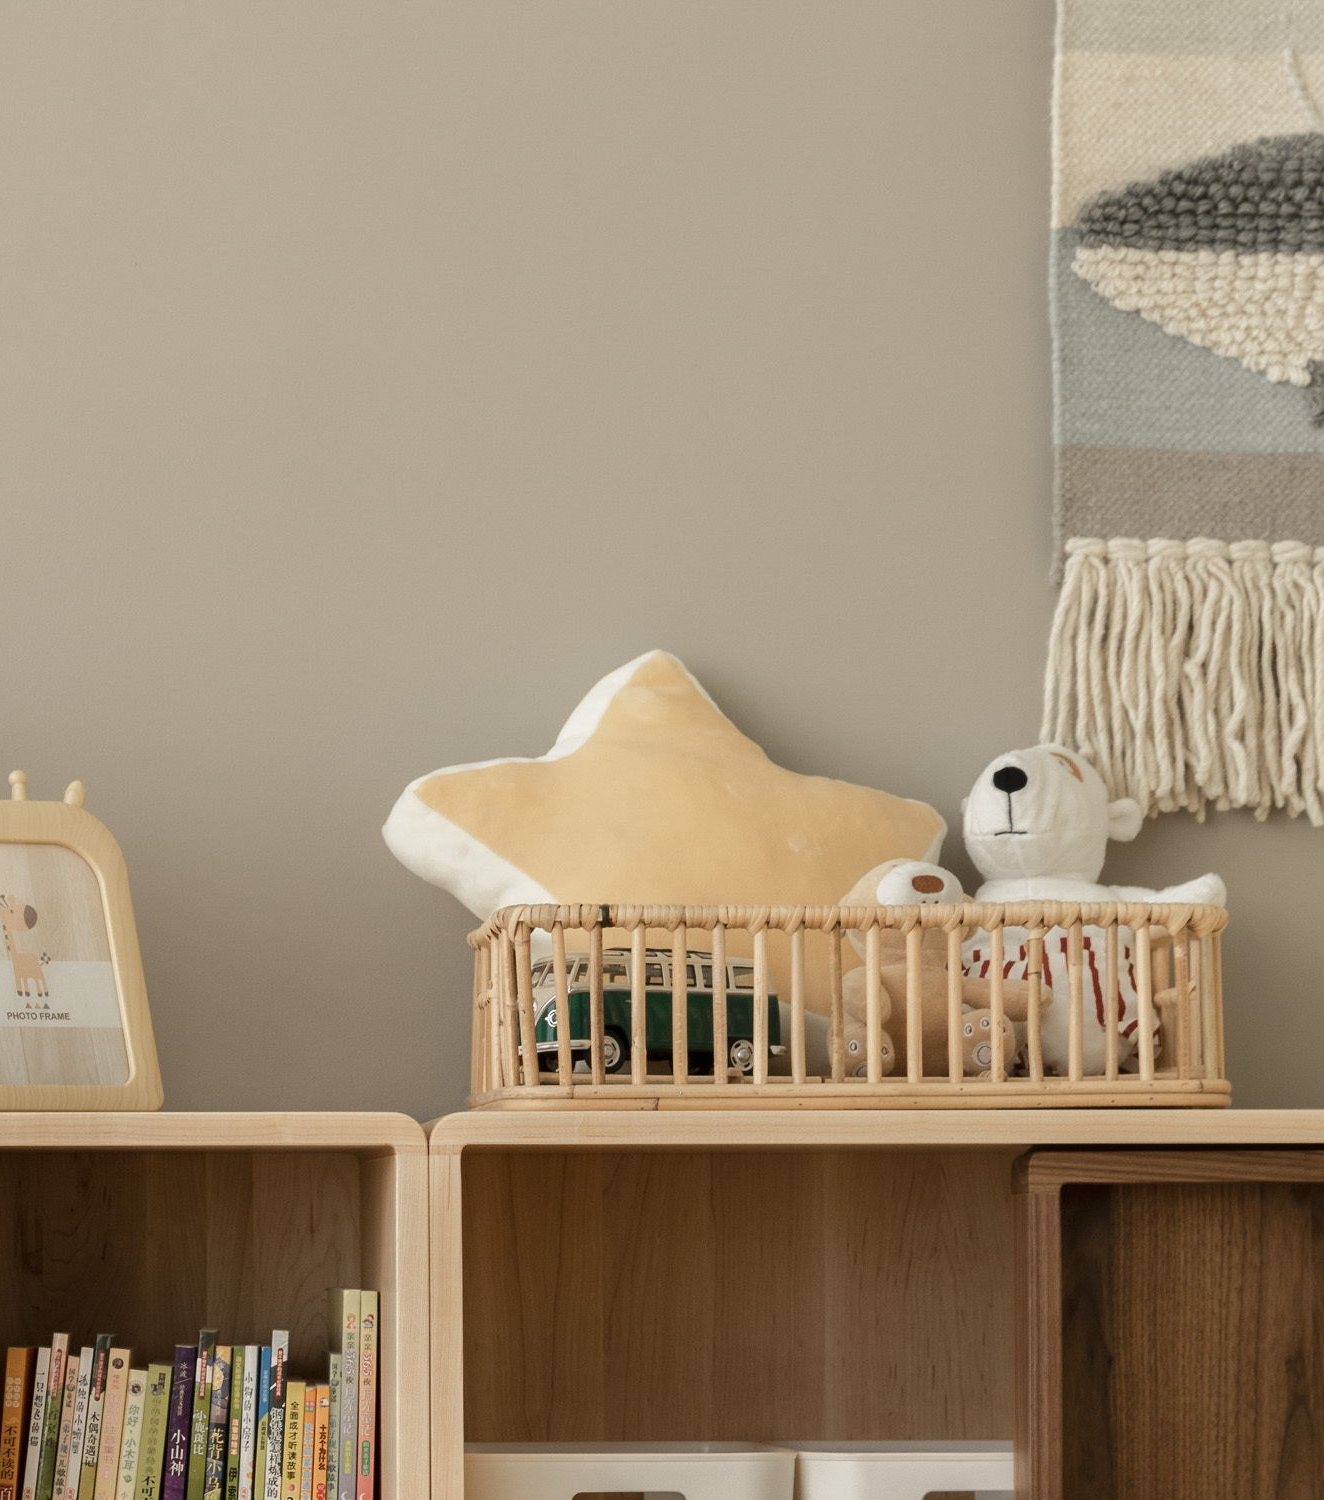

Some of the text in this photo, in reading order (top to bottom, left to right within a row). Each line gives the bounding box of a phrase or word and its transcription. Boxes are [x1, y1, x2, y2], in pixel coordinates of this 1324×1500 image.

[6, 1011, 71, 1021] PHOTO FRAME
[30, 1371, 46, 1447] 一只想飞的猫
[71, 1373, 89, 1454] 孤独的小螃蟹
[83, 1412, 100, 1468] 木偶奇遇记
[192, 1409, 207, 1456] 小鹿斑比
[242, 1371, 254, 1453] 小狗的小房子
[286, 1401, 300, 1481] 全面成才听读故事
[167, 1429, 186, 1477] 小山神
[266, 1408, 285, 1500] 钢铁是怎样炼成的
[318, 1424, 328, 1471] 十万个为什么
